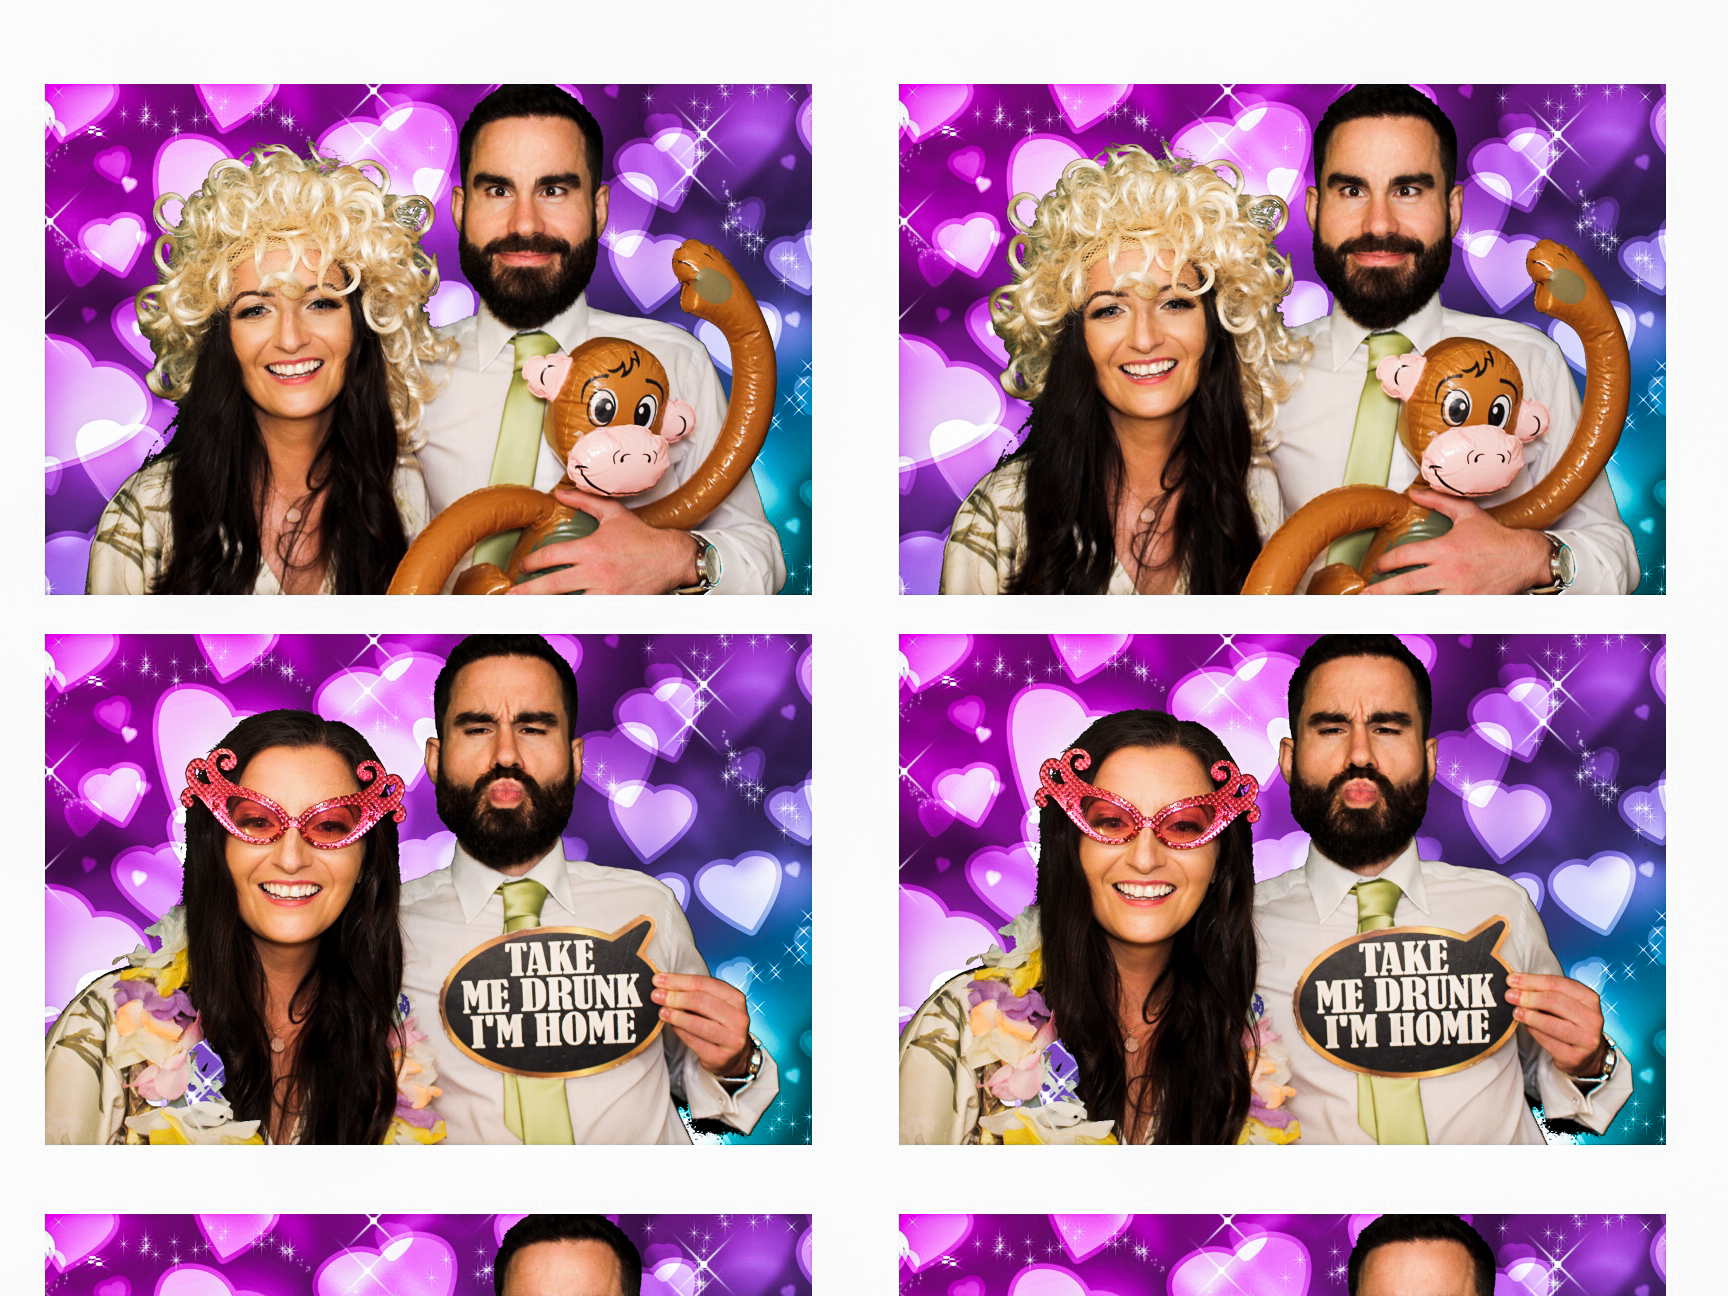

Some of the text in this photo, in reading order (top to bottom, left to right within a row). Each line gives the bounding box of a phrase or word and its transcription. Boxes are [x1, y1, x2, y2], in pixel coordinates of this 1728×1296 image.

[505, 939, 595, 977] TAKE
[1359, 939, 1449, 977] TAKE
[461, 973, 643, 1014] ME DRUNK
[1315, 973, 1497, 1014] ME DRUNK
[470, 1009, 636, 1049] I'M HOME
[1324, 1009, 1490, 1049] I'M HOME
